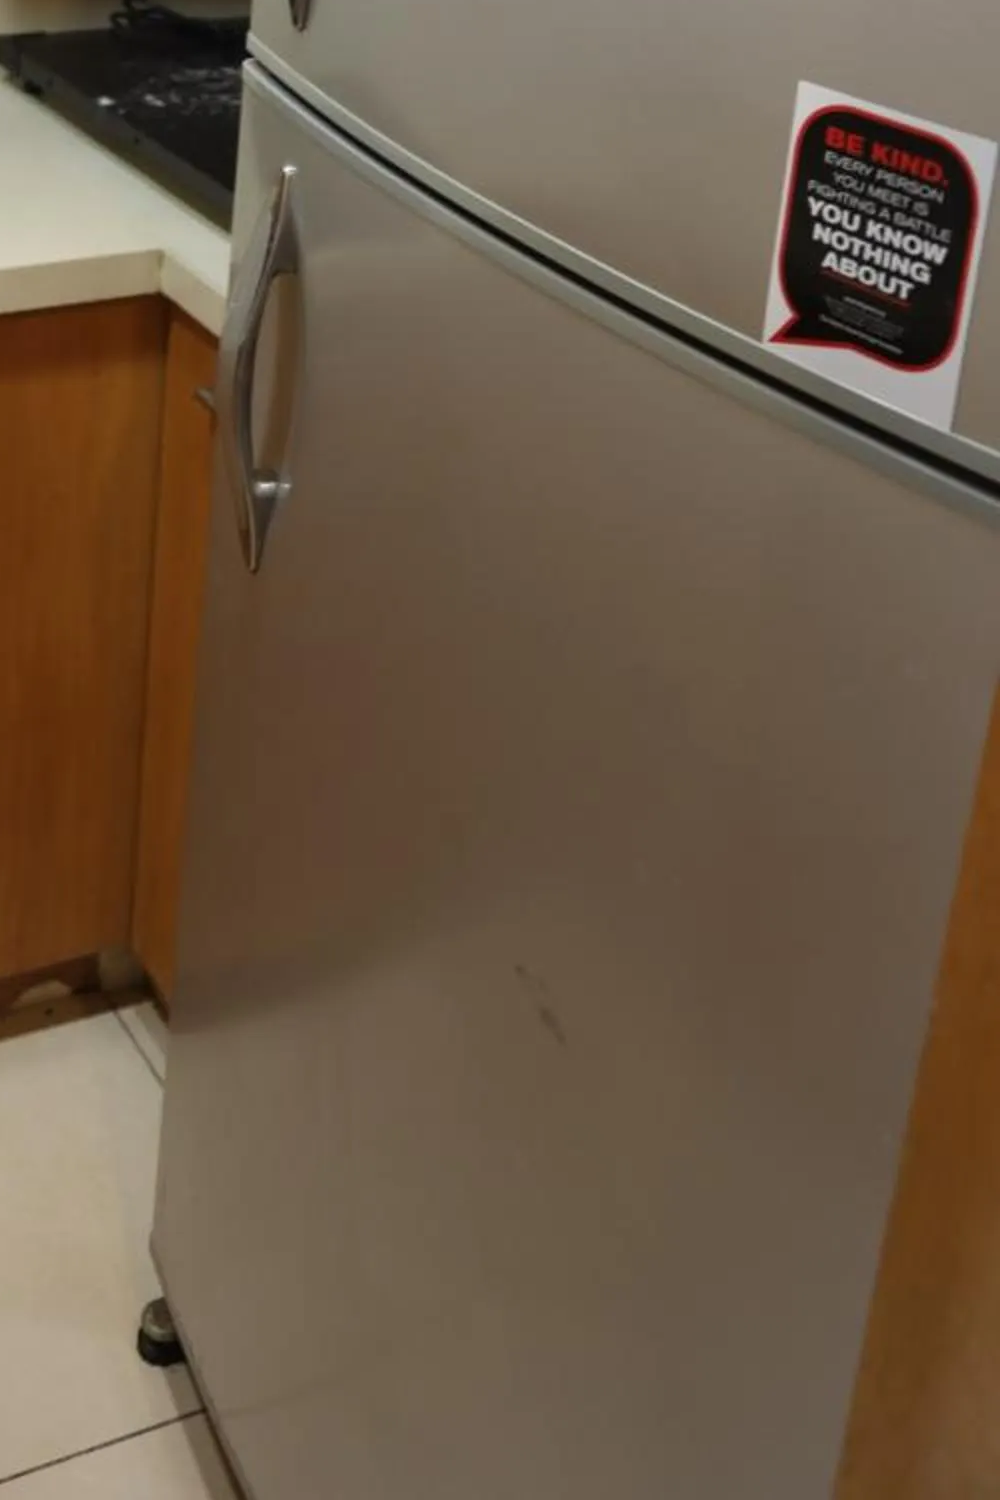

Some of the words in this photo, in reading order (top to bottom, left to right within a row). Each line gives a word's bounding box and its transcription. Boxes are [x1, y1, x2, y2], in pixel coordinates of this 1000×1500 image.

[825, 126, 863, 155] BE
[824, 150, 874, 177] EVERY
[876, 168, 945, 204] PERSON
[833, 171, 866, 193] YOU
[867, 184, 912, 209] MEET
[912, 201, 930, 217] IS
[807, 179, 877, 215] FIGHTING
[878, 207, 891, 222] A
[893, 211, 953, 243] BATTLE
[807, 195, 861, 232] YOU
[866, 219, 949, 265] KNOW
[812, 222, 933, 285] NOTHING
[821, 250, 915, 300] ABOUT
